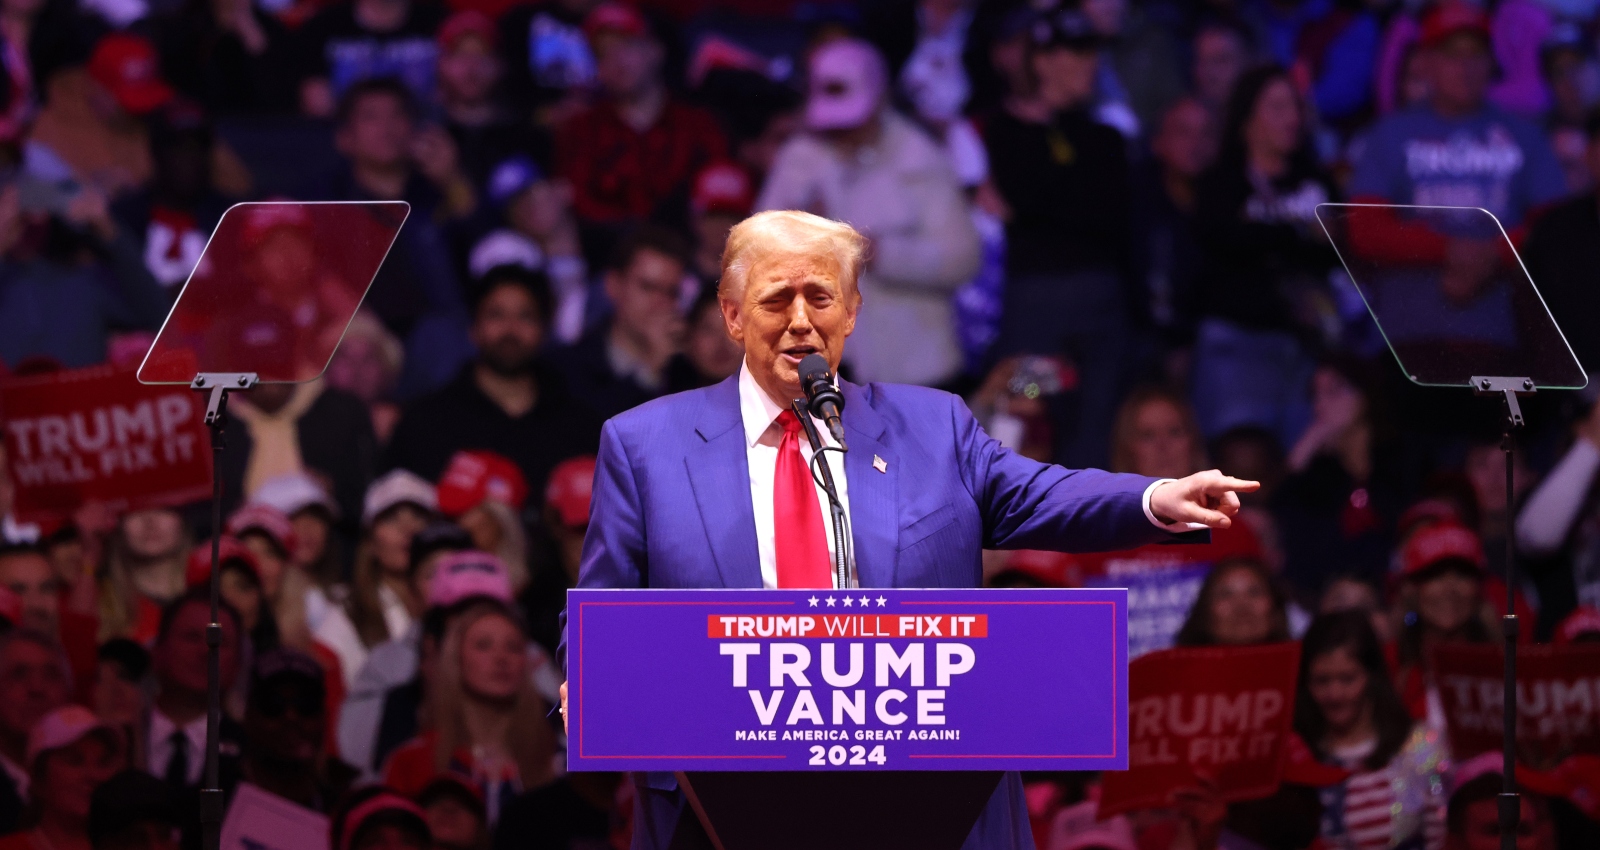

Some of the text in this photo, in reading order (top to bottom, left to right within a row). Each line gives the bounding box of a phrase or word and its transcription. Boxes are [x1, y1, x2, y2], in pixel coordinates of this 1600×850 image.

[8, 392, 194, 459] TRUMP
[14, 430, 198, 487] WILL FIX IT
[720, 616, 976, 637] TRUMP WILL FIX IT
[720, 642, 976, 687] TRUMP
[748, 689, 946, 726] VANCE
[1444, 674, 1600, 715] TRUM
[735, 729, 961, 741] MAKE AMERICA GREAT AGAIN!
[1130, 730, 1278, 766] ILL FIX IT
[808, 744, 888, 766] 2024
